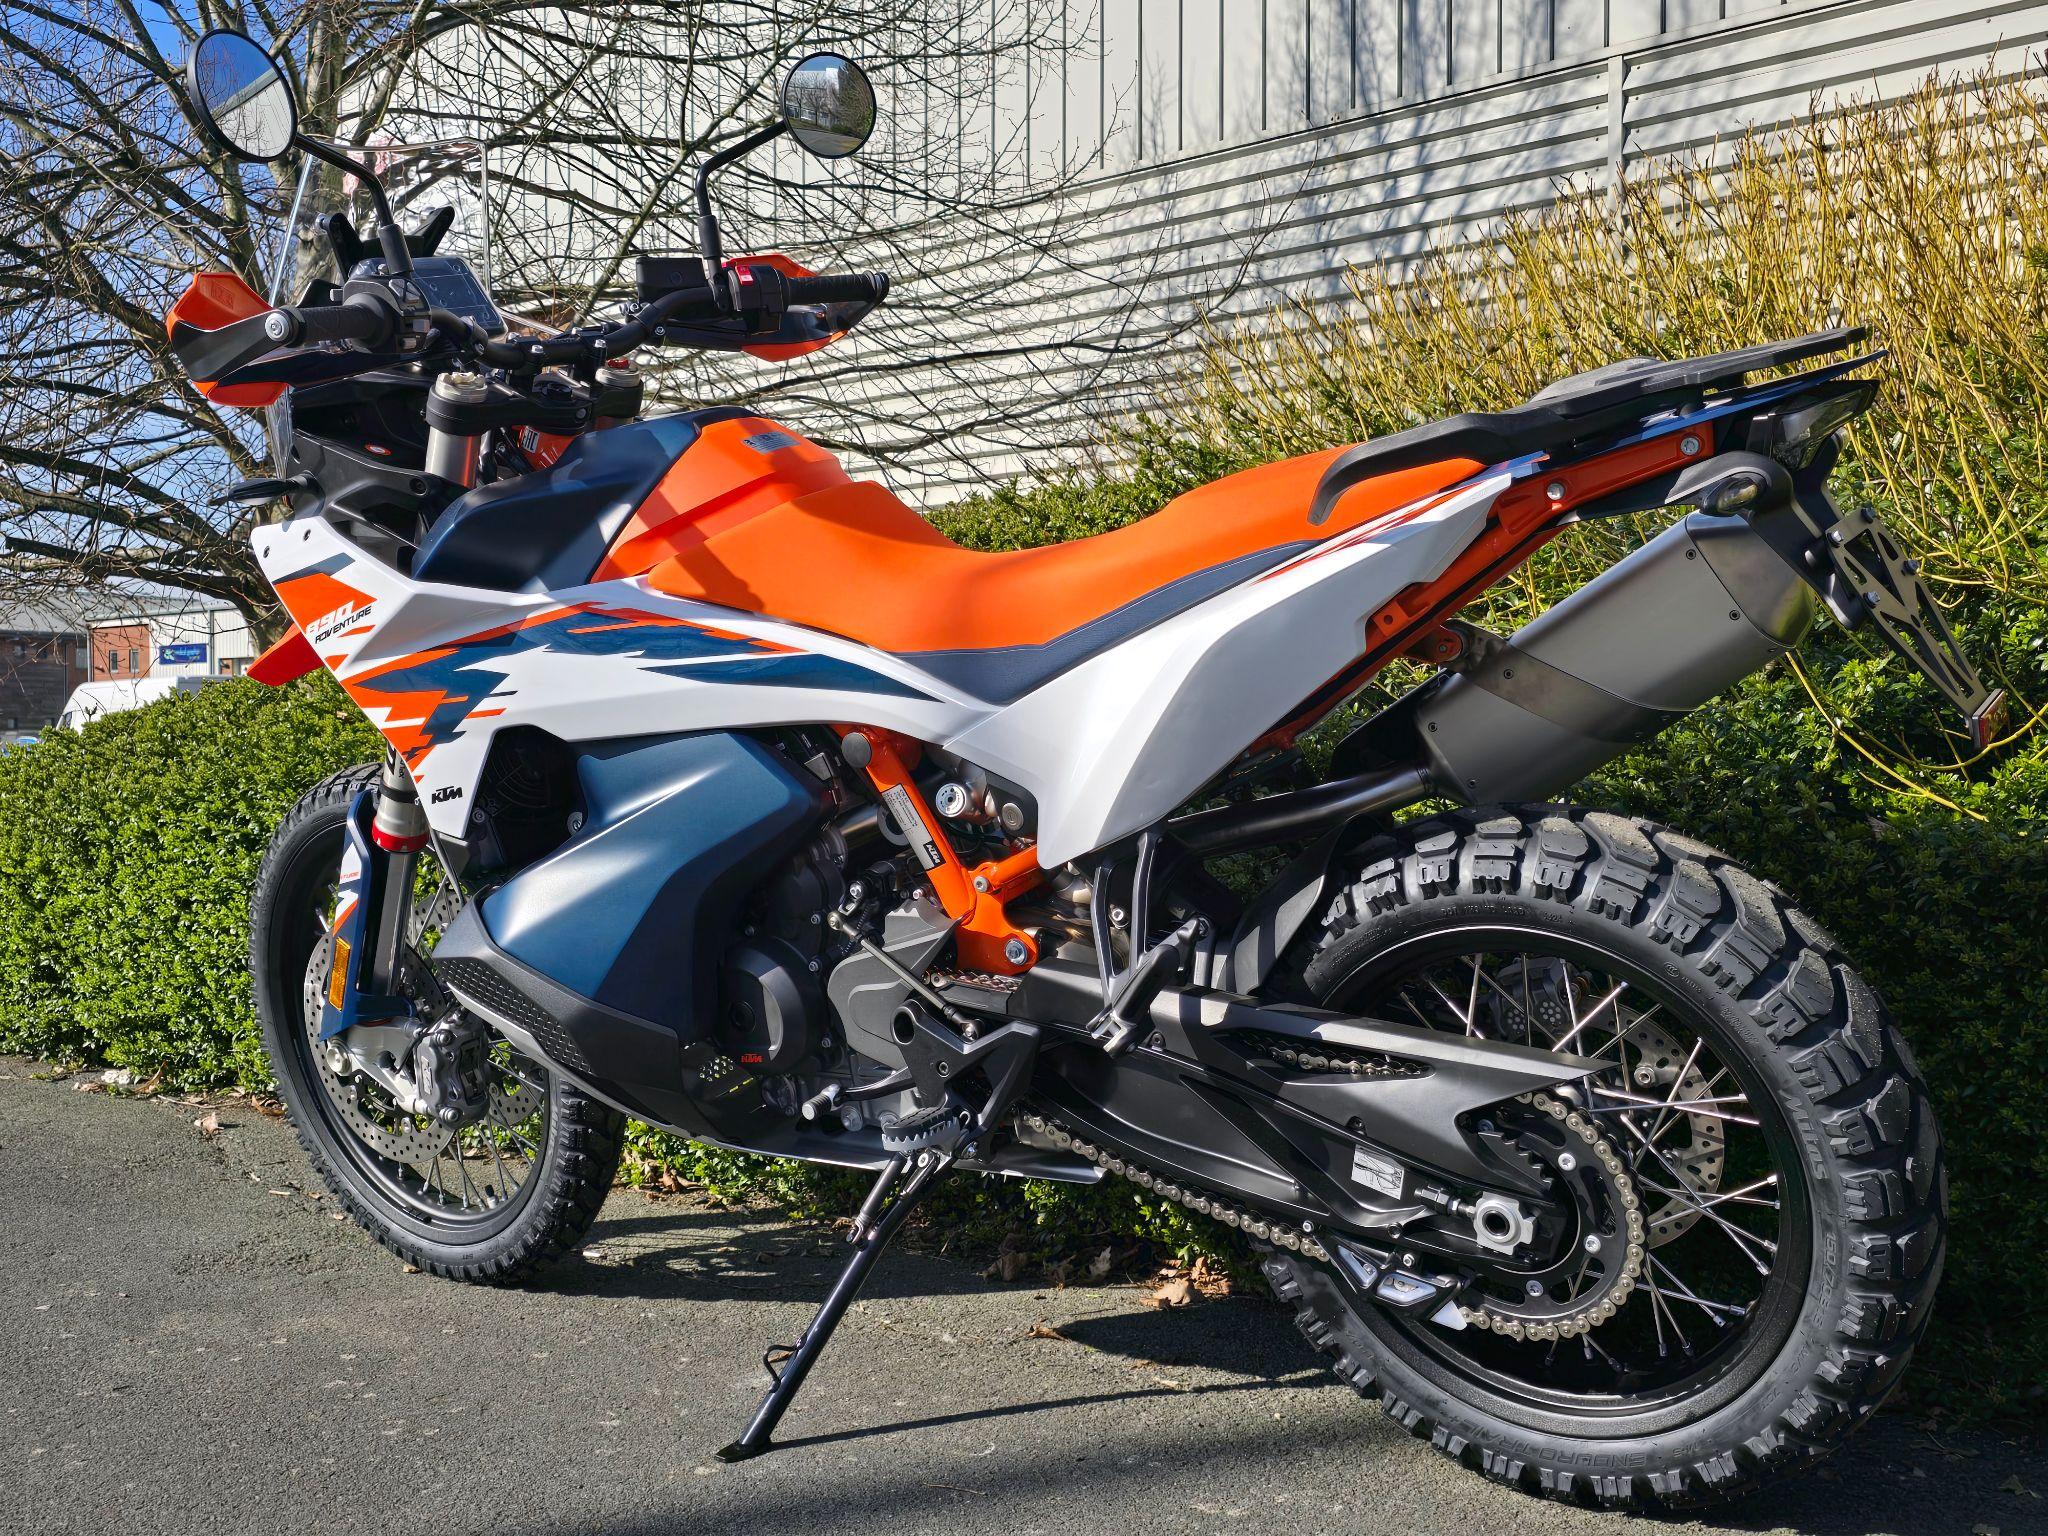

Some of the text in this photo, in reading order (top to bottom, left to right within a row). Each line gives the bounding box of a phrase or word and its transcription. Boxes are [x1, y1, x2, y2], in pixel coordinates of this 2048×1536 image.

[305, 599, 355, 637] 890
[314, 605, 373, 644] ADVENTURE
[431, 785, 464, 805] KTM
[741, 1053, 762, 1063] KTM
[342, 1188, 391, 1236] ENDURO
